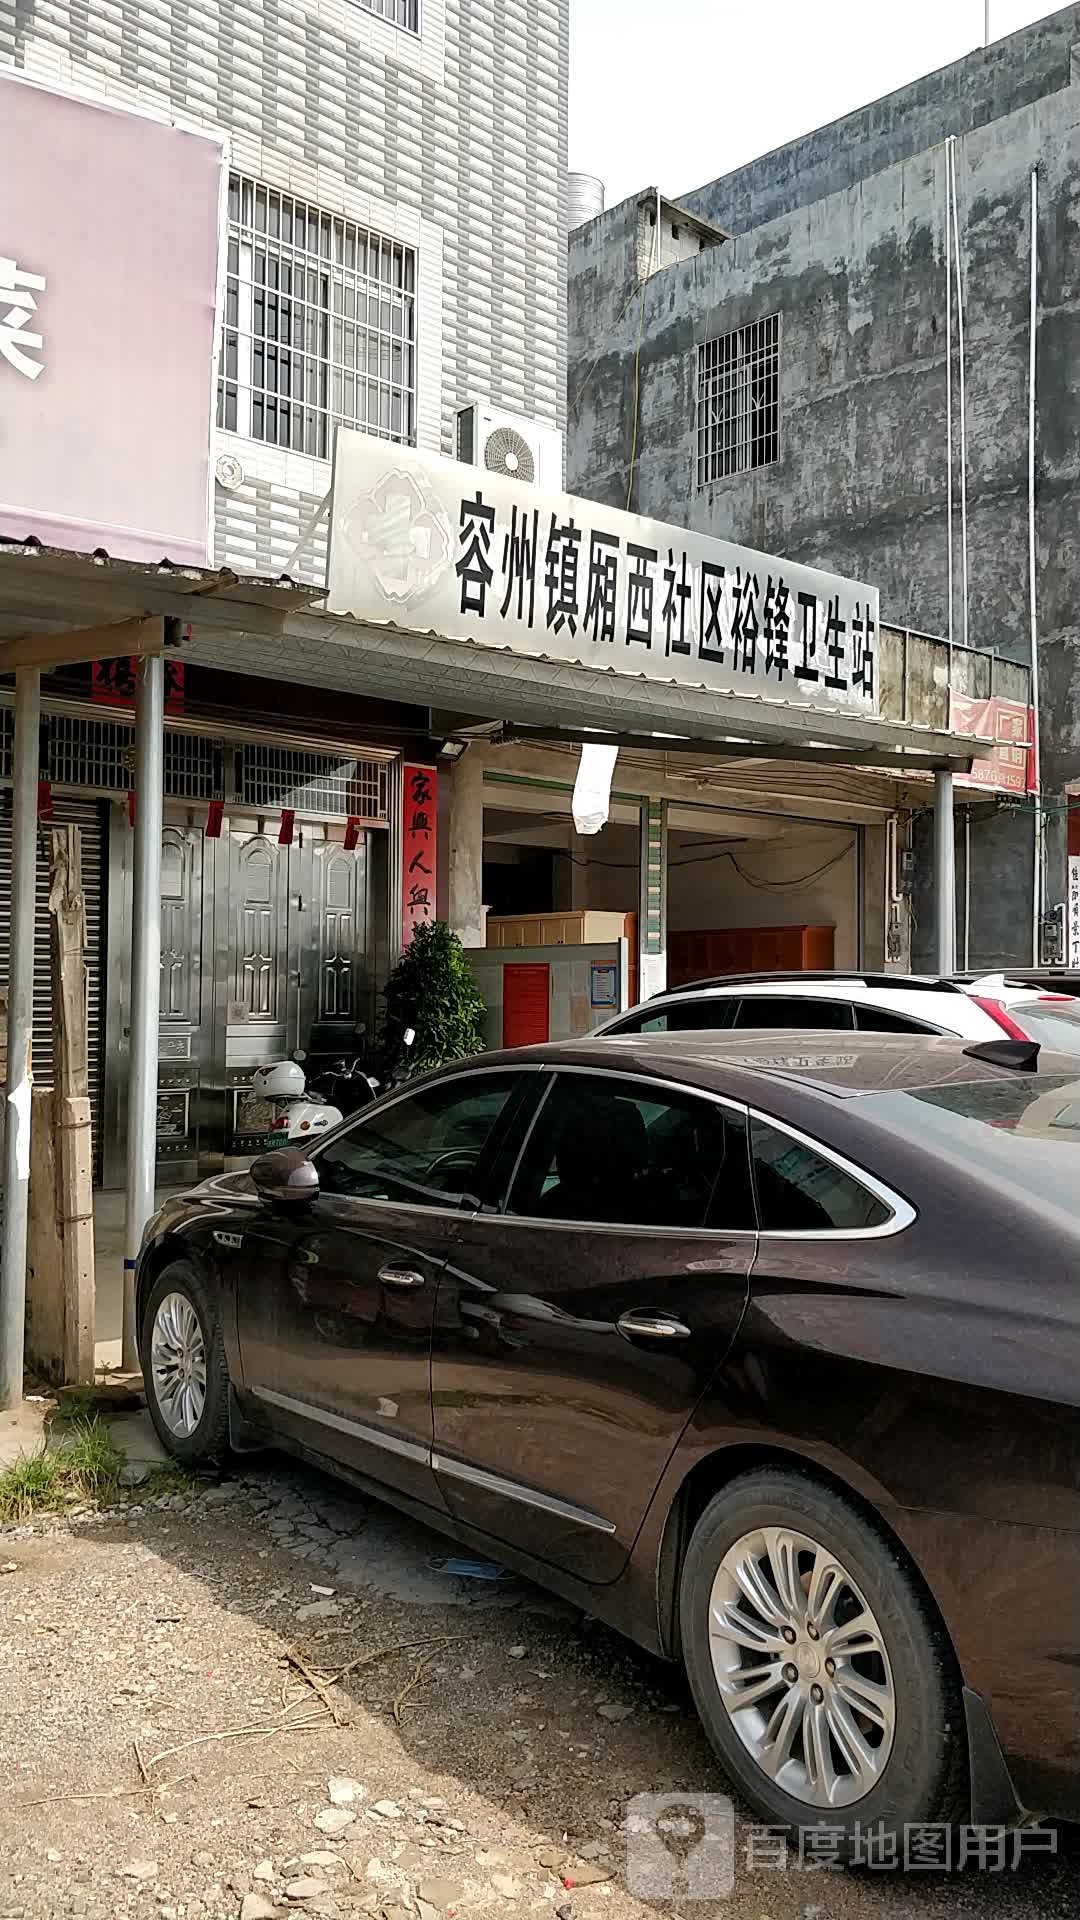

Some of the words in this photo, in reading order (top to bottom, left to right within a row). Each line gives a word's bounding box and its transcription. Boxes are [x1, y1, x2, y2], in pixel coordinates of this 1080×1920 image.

[455, 491, 875, 699] 容州镇厢西社区裕锋卫生站
[407, 772, 432, 930] 家興人興
